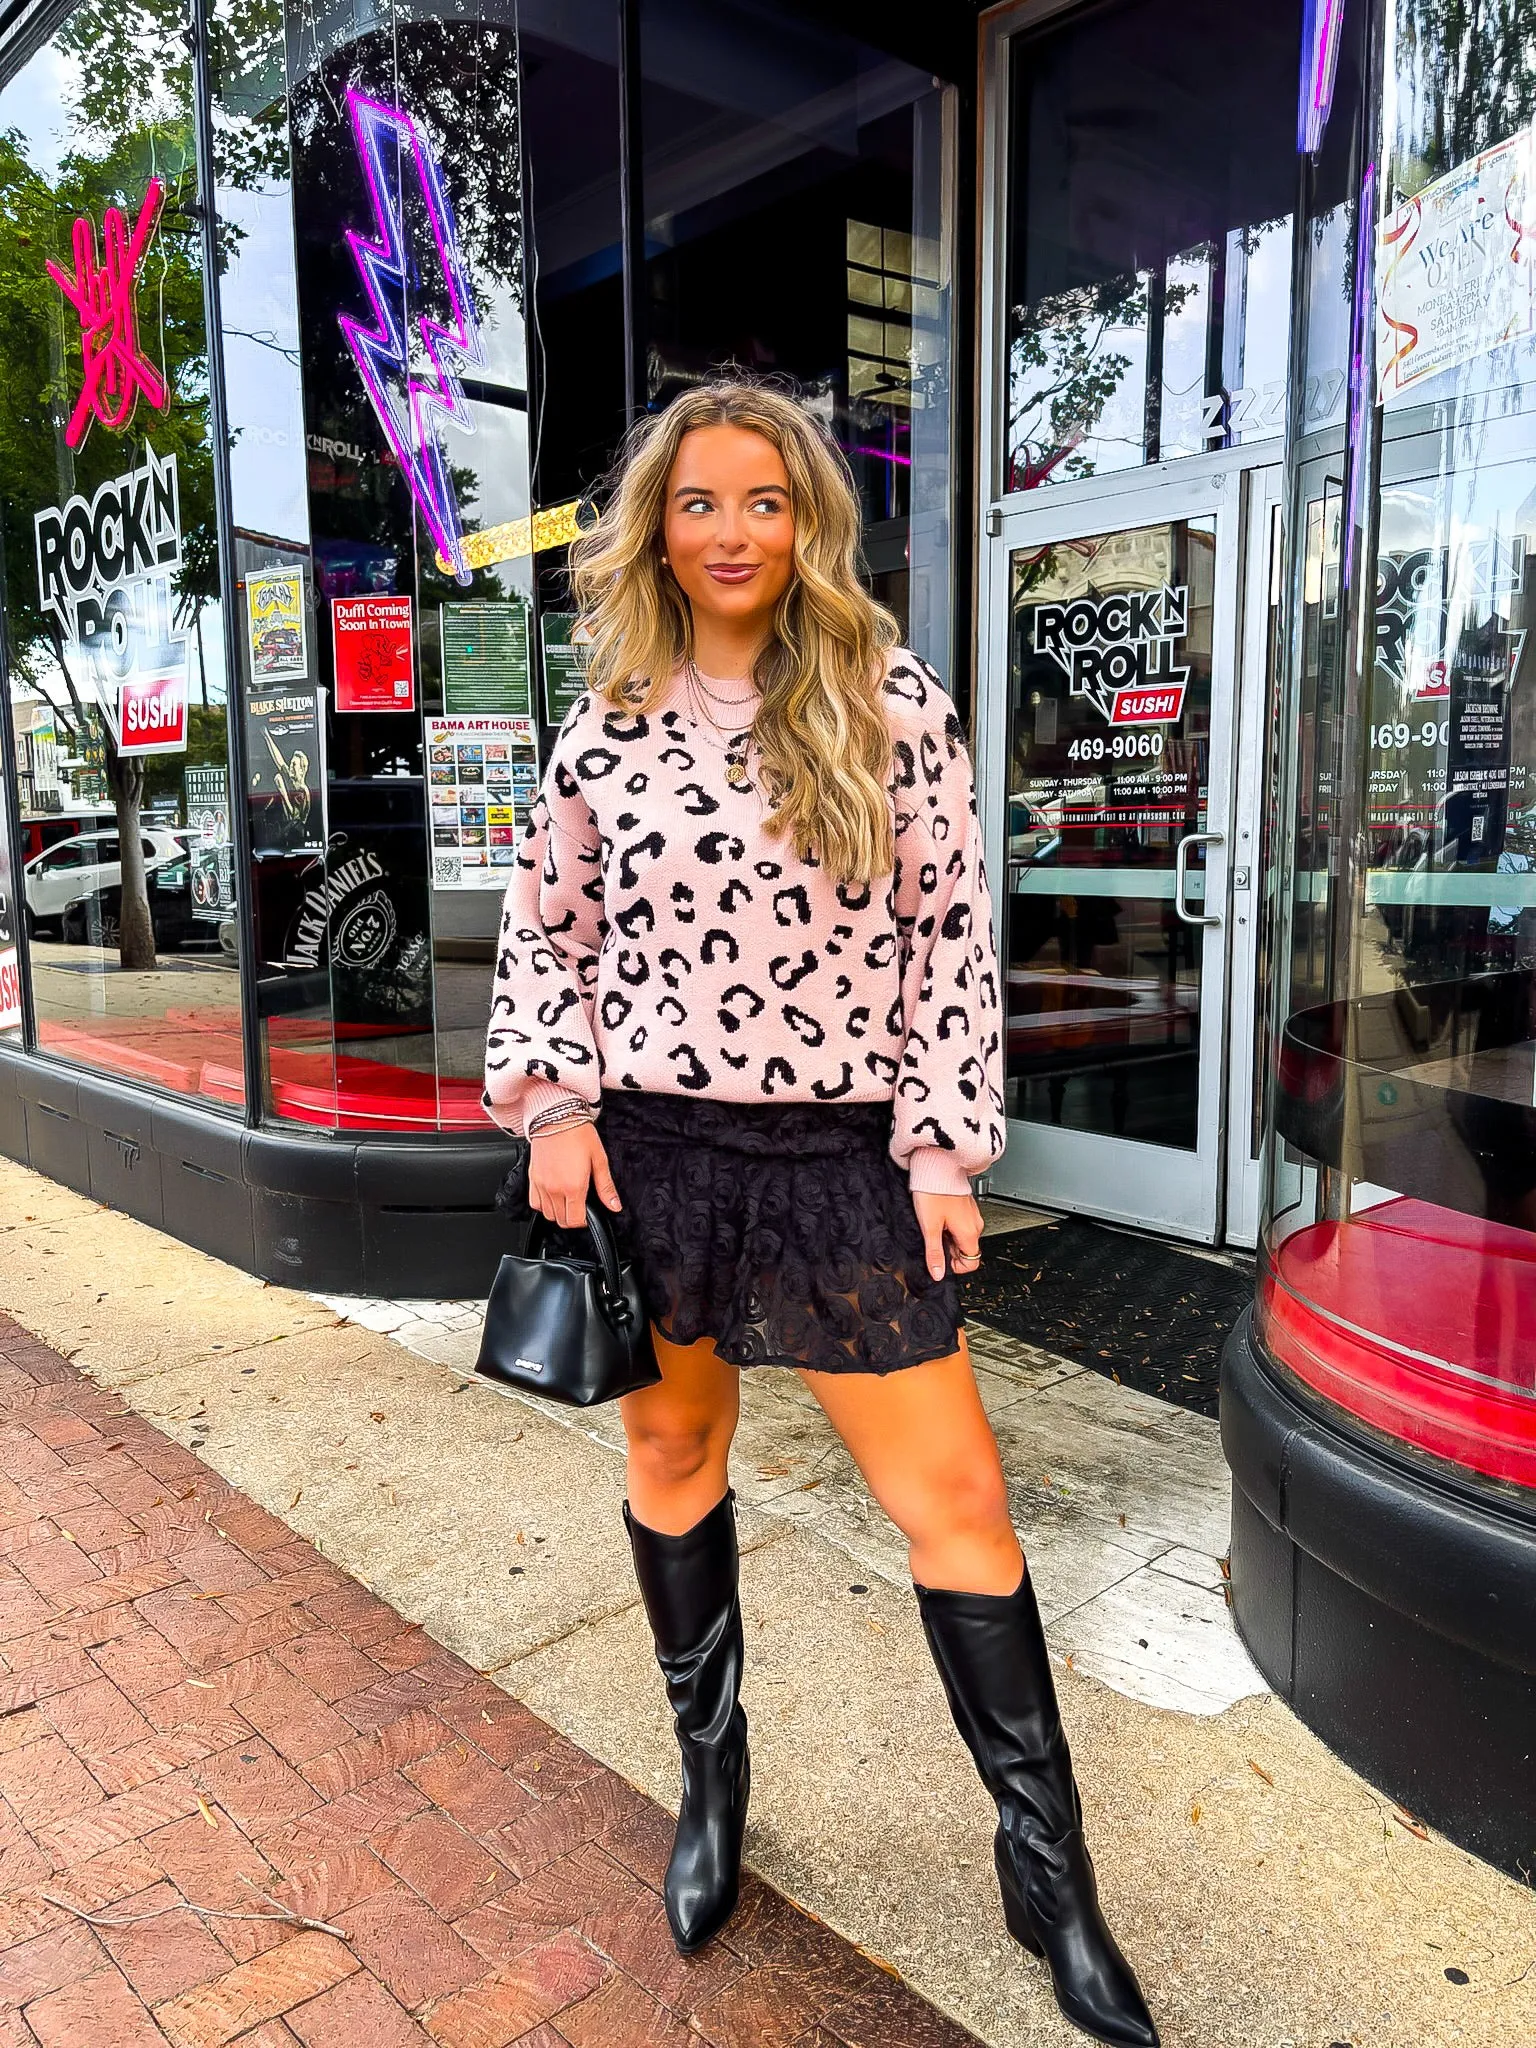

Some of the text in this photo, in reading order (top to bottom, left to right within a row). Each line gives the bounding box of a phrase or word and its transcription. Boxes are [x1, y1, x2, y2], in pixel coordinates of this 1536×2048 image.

[366, 603, 410, 618] Coming
[339, 619, 367, 631] Soon
[1069, 637, 1191, 697] ROLL
[127, 696, 182, 734] SUSHI
[250, 695, 314, 716] BLAKE SHELTON
[1120, 695, 1175, 716] SUSHI
[432, 721, 530, 730] BAMA ART HOUSE
[1067, 733, 1164, 761] 469-9060
[1029, 779, 1059, 788] SUNDAY
[1062, 776, 1103, 787] THURSDAY
[1117, 775, 1135, 784] 11:00
[1137, 775, 1150, 783] AM
[1155, 774, 1173, 783] 9:00
[1175, 773, 1188, 782] PM
[1058, 787, 1096, 798] SATURDAY
[1113, 787, 1132, 796] 11:00
[1133, 786, 1146, 795] AM
[1152, 785, 1173, 794] 10:00
[1174, 785, 1187, 793] PM
[286, 848, 383, 967] JACK DANIEL'S
